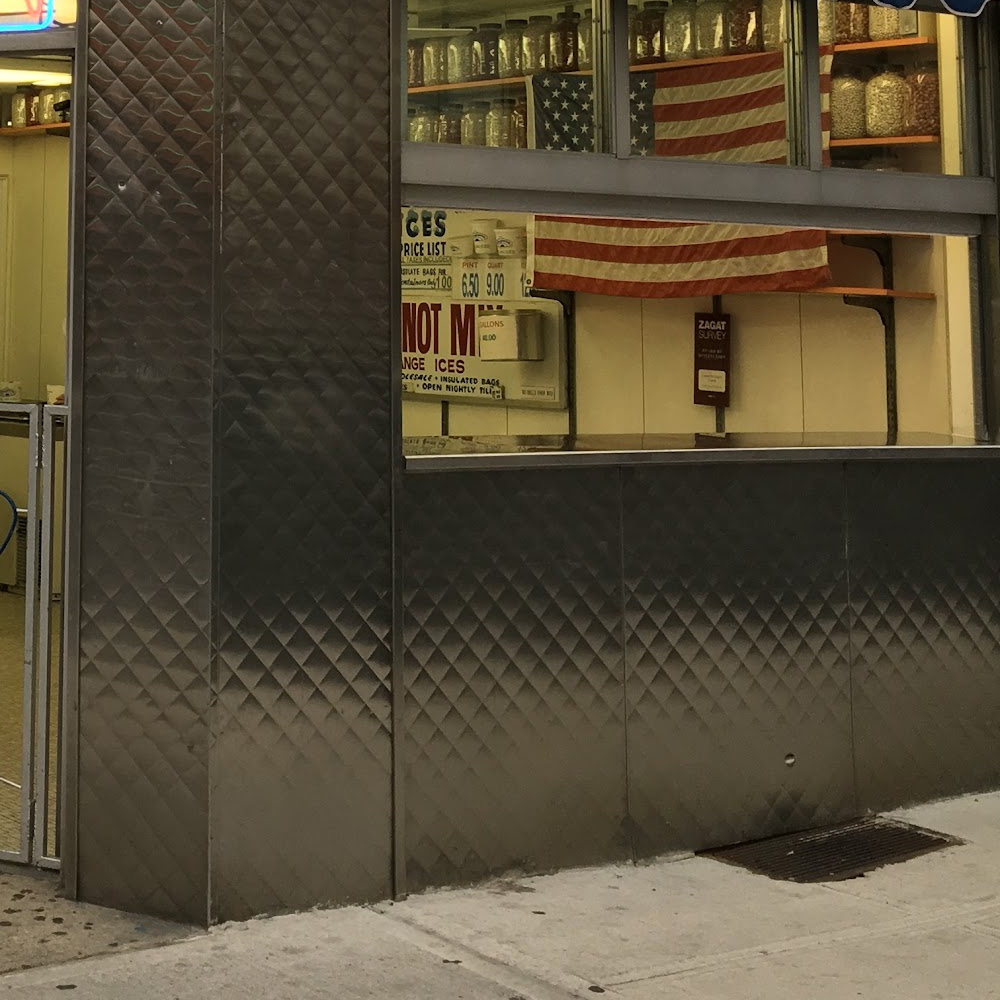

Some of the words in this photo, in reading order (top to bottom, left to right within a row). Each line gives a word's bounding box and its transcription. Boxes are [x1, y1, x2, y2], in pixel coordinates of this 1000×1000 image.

[401, 209, 447, 237] CES
[427, 242, 446, 256] LIST
[462, 273, 479, 297] 6.50
[486, 272, 504, 296] 9.00
[402, 302, 441, 354] NOT
[699, 320, 726, 330] ZAGAT
[699, 330, 726, 340] SURVEY
[435, 358, 465, 374] ICES
[440, 376, 478, 385] INSULATED
[422, 383, 442, 391] OPEN
[446, 384, 476, 394] NIGHTLY
